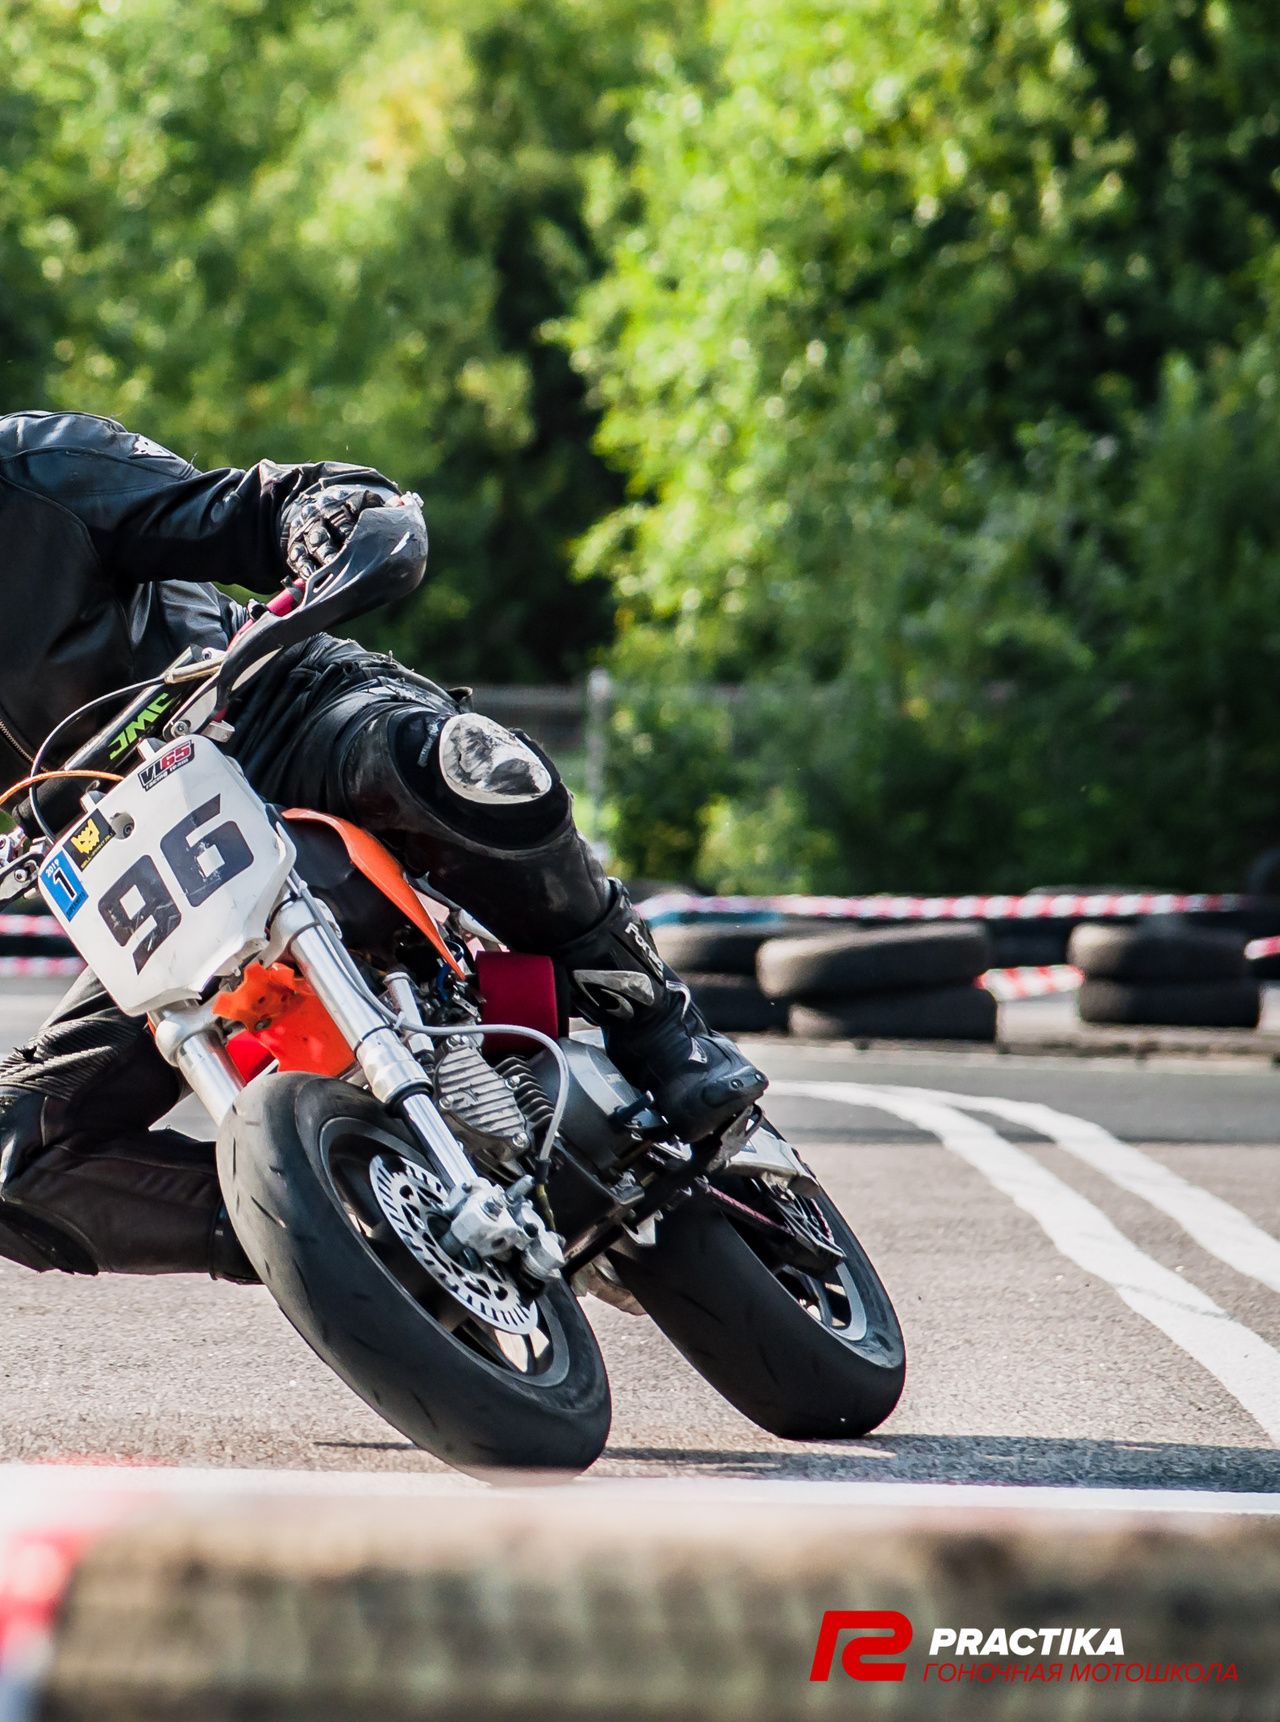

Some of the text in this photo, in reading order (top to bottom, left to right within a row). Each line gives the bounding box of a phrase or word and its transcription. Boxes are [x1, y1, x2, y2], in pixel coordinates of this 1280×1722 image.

[107, 692, 172, 760] JMC
[145, 769, 169, 790] racing
[45, 858, 61, 878] 2019
[52, 866, 78, 902] 1
[97, 793, 254, 976] 96
[65, 890, 87, 918] SUPERMOTO
